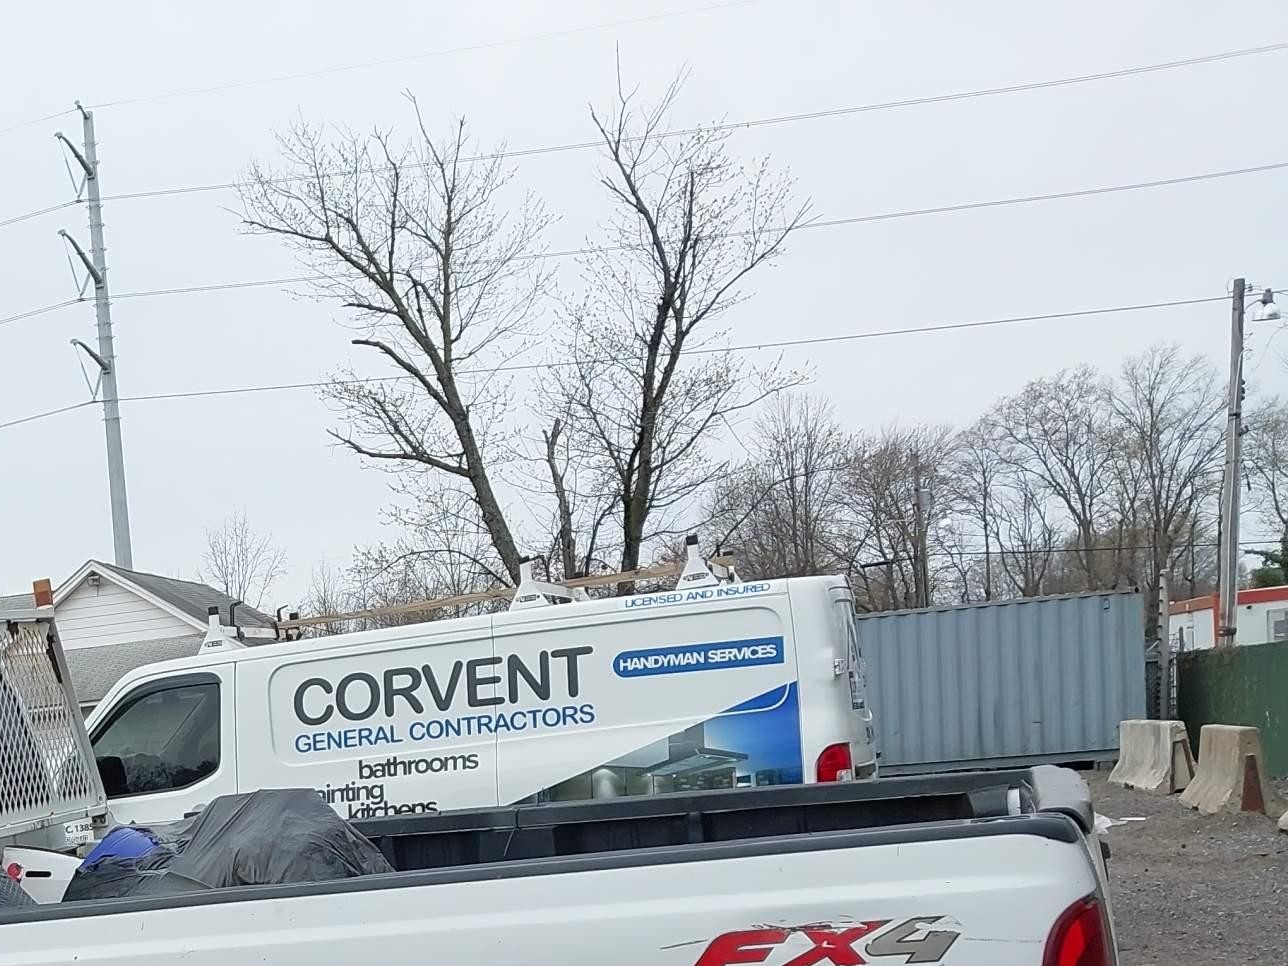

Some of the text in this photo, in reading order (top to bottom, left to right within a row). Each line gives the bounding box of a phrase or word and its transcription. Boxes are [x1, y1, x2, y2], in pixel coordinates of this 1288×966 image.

[625, 582, 771, 608] LICENSED AND INSURED
[619, 644, 777, 672] HANDYMAN SERVICES
[293, 646, 594, 726] CORVENT
[295, 704, 595, 753] GENERAL CONTRACTORS
[358, 753, 479, 780] bathrooms
[315, 781, 384, 805] inting
